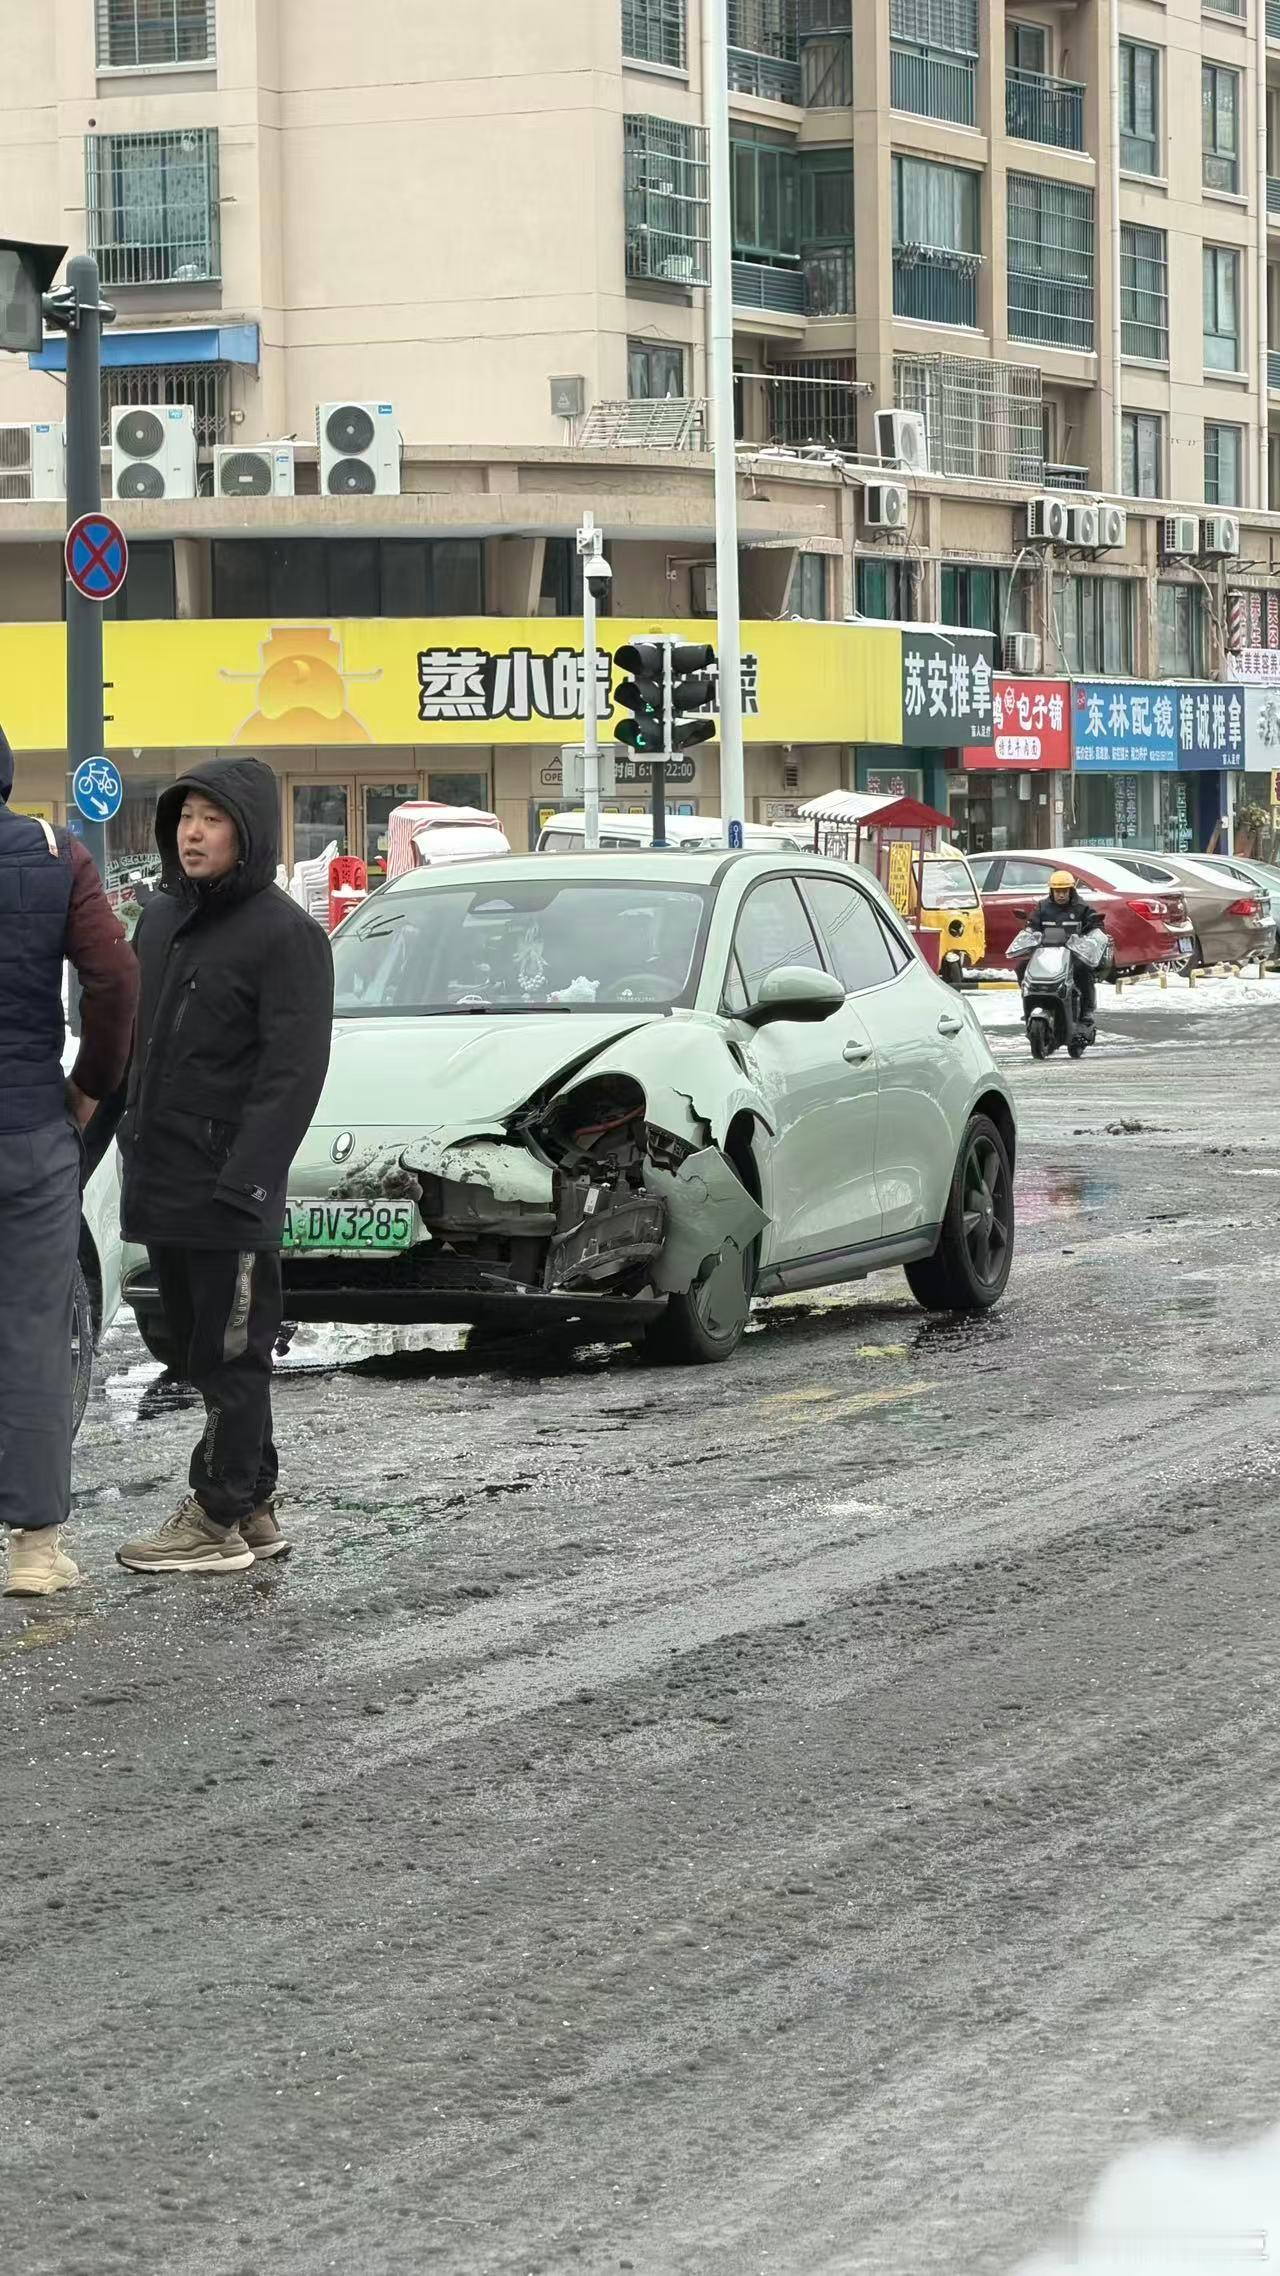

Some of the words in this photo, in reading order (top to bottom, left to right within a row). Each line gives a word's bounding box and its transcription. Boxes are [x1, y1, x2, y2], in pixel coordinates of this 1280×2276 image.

[417, 647, 615, 721] 蒸小皖
[904, 651, 992, 718] 苏安推拿
[1085, 693, 1174, 738] 东林配镜
[1180, 694, 1242, 750] 精诚推拿
[545, 773, 562, 782] OPE
[639, 763, 693, 777] 6:-22:00
[308, 1207, 409, 1240] DV3285
